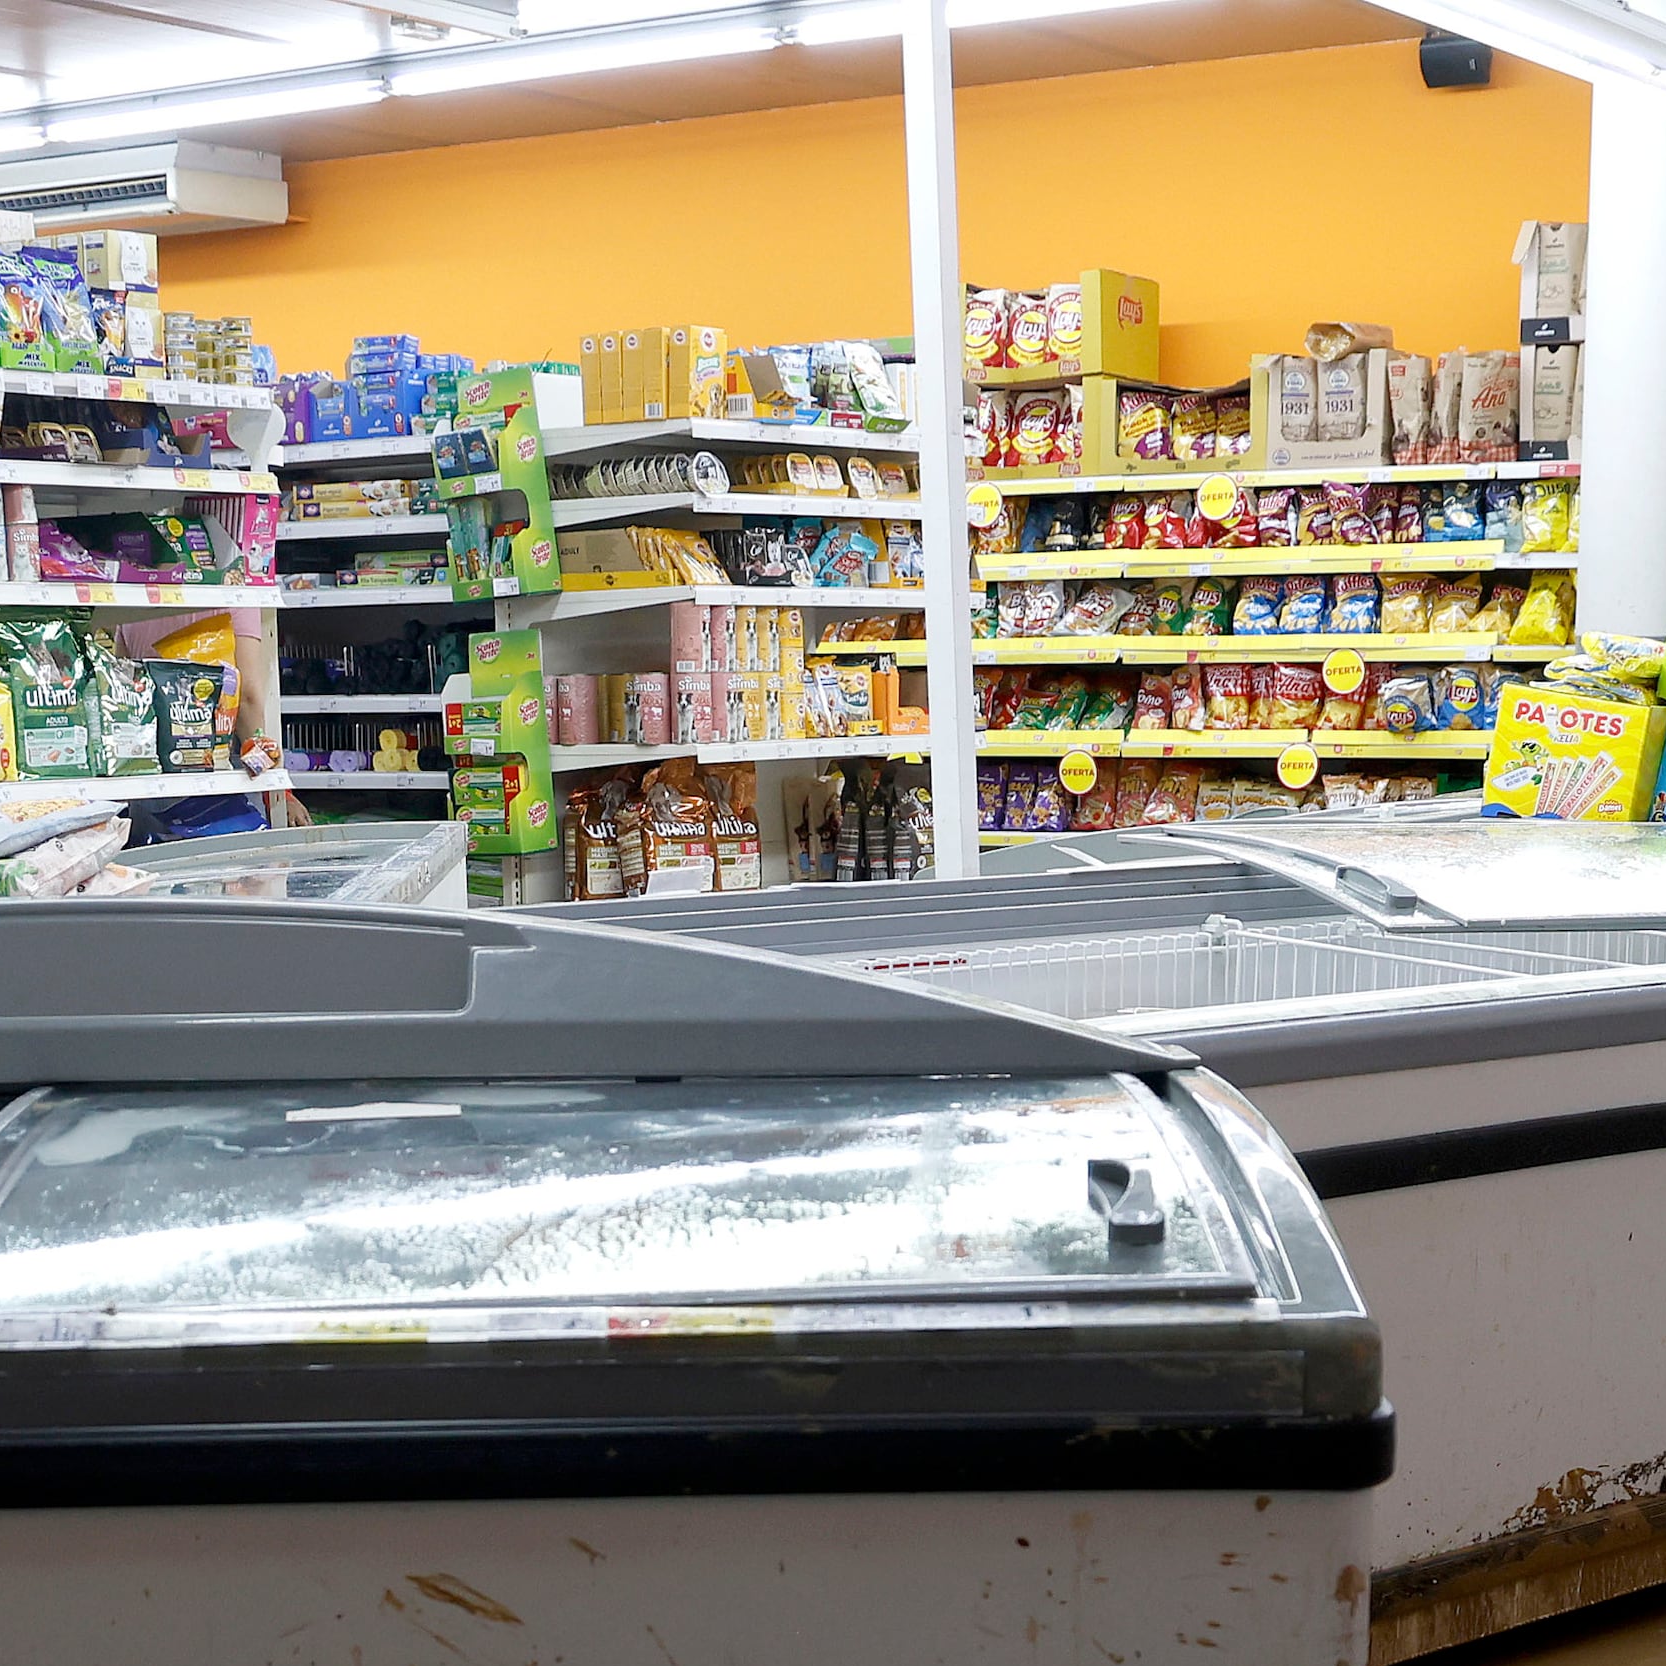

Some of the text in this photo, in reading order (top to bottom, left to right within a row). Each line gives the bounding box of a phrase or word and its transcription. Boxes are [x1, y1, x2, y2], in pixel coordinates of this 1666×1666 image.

[24, 351, 42, 361] MIX
[75, 360, 91, 369] MIX
[464, 379, 491, 399] Scotch
[468, 387, 489, 405] Brite
[1325, 399, 1354, 413] 1931
[1471, 388, 1506, 409] Ana
[516, 437, 535, 450] Scotch
[520, 447, 535, 461] Brite
[1200, 491, 1235, 503] OFERTA
[531, 540, 550, 557] Scotch
[535, 550, 550, 565] Brite
[476, 639, 501, 654] Scotch
[479, 648, 499, 661] Brite
[1325, 664, 1363, 676] OFERTA
[1279, 674, 1310, 693] Ana
[26, 686, 77, 708] ultima
[519, 699, 538, 714] Scotch
[45, 716, 68, 725] ADULTO
[522, 708, 538, 724] Brite
[1515, 702, 1622, 736] PAOTES
[1061, 767, 1095, 777] OFERTA
[1281, 761, 1318, 771] OFERTA
[505, 779, 519, 789] 2+1
[1567, 772, 1594, 809] PALOTES
[529, 801, 548, 817] Scotch
[531, 811, 547, 826] Brite
